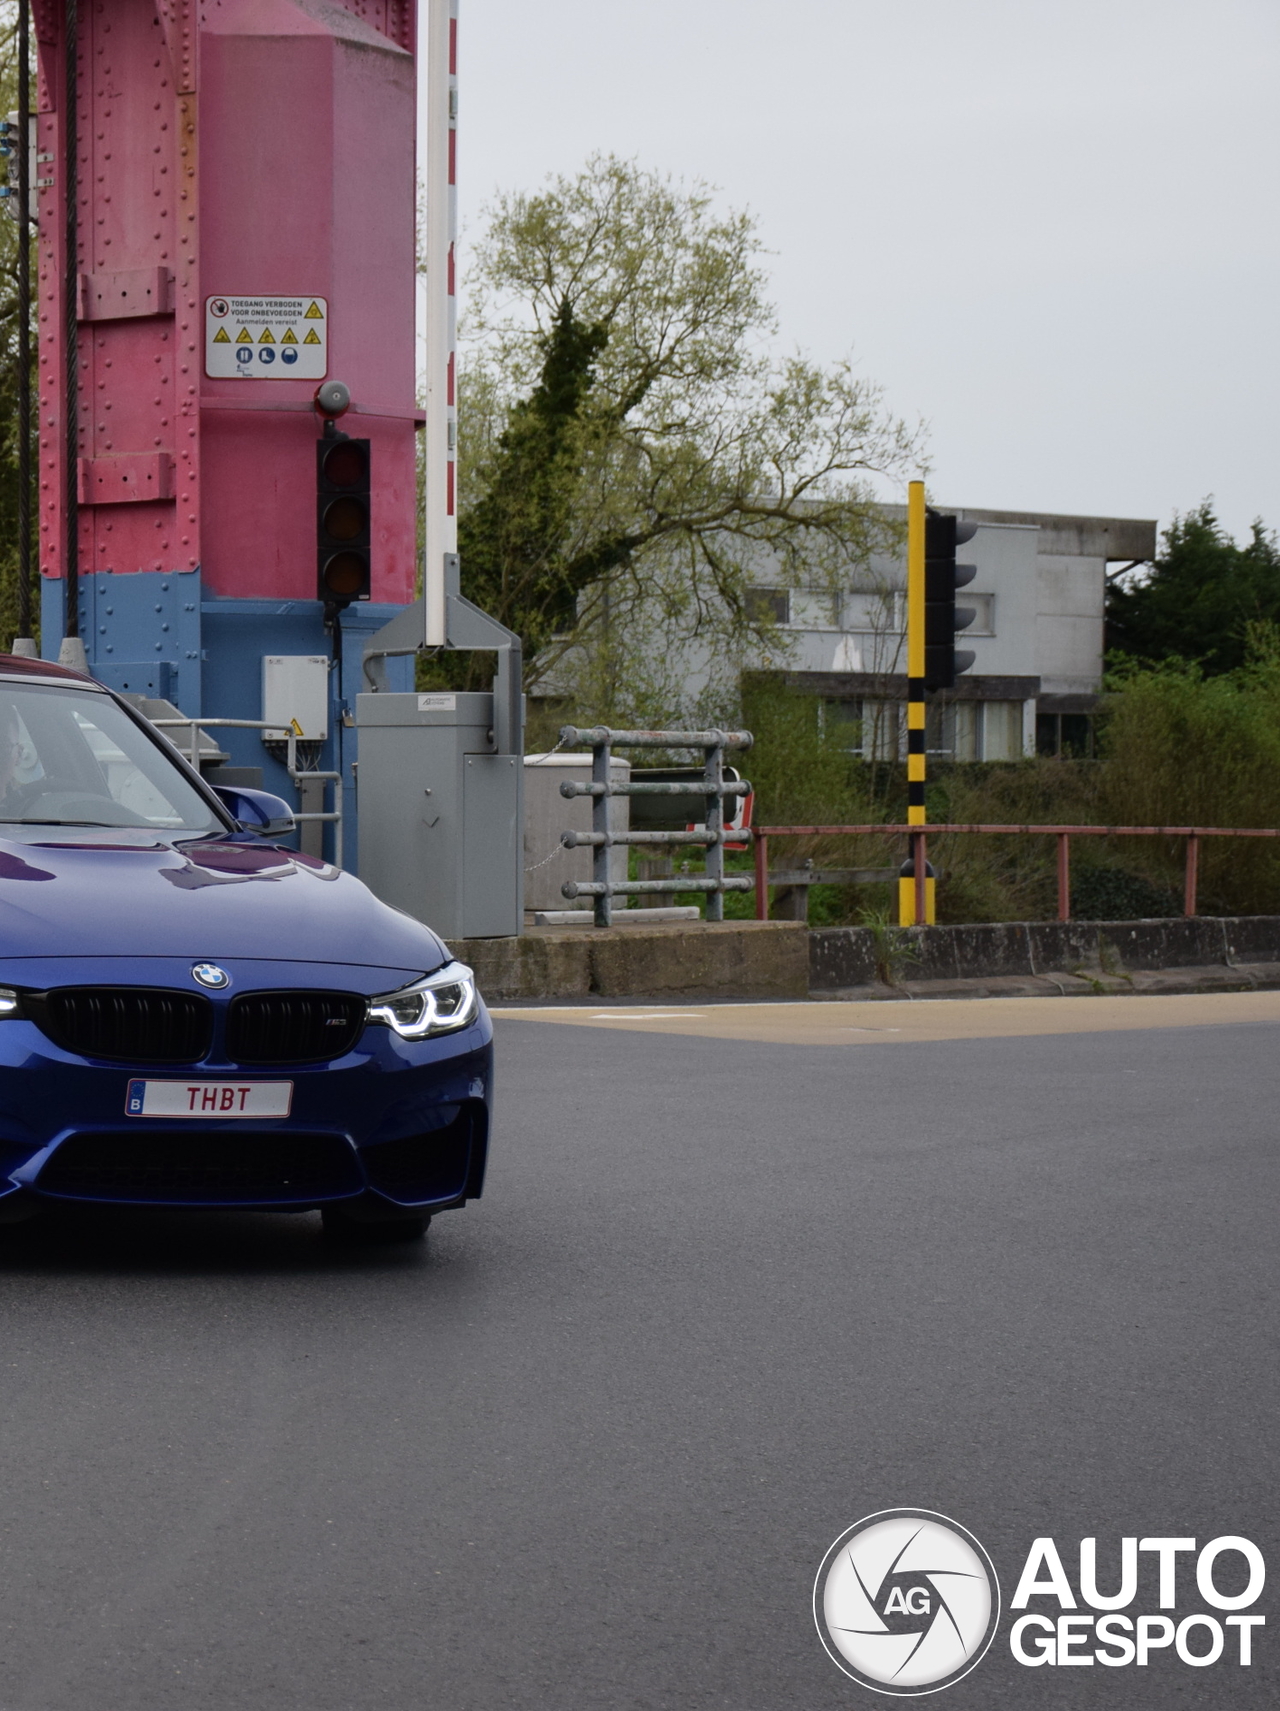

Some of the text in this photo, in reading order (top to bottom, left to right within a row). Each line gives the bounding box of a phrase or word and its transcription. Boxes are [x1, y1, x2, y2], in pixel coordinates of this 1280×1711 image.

[231, 300, 302, 308] TOEGANG VERBODEN
[251, 309, 302, 317] ONBEVOEGDEN
[130, 1087, 251, 1111] B THBT
